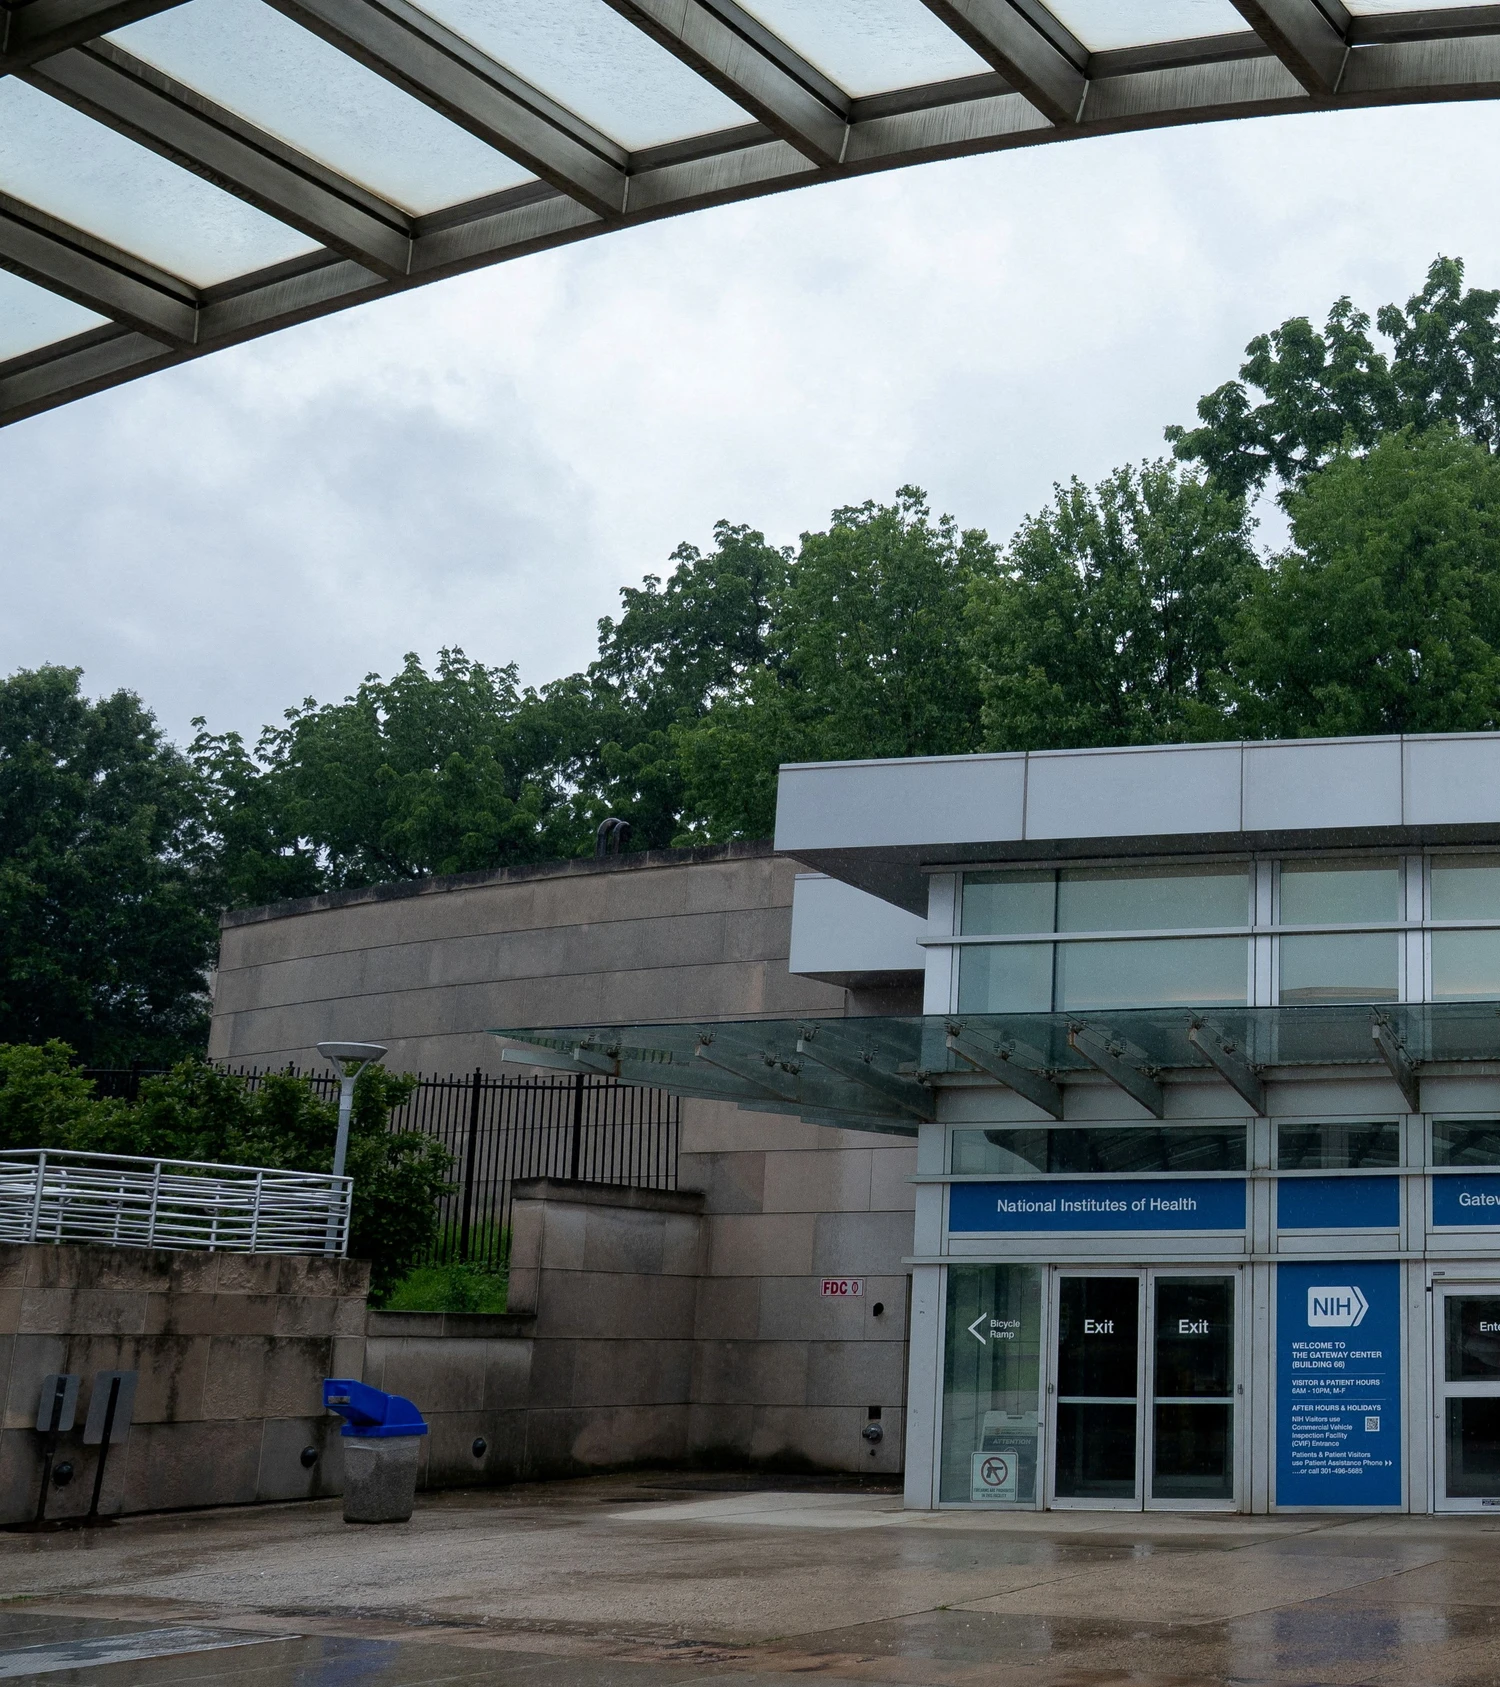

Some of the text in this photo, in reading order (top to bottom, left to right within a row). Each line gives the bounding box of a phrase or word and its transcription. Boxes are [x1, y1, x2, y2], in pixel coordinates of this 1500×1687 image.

[997, 1197, 1197, 1212] National Institutes of Health
[824, 1281, 848, 1294] FDC
[1314, 1297, 1351, 1316] NIH
[990, 1320, 1020, 1329] Bicycle
[1084, 1319, 1114, 1334] Exit
[1178, 1319, 1209, 1334] Exit
[990, 1330, 1014, 1339] Ramp
[1292, 1361, 1345, 1369] (BUILDING 66)
